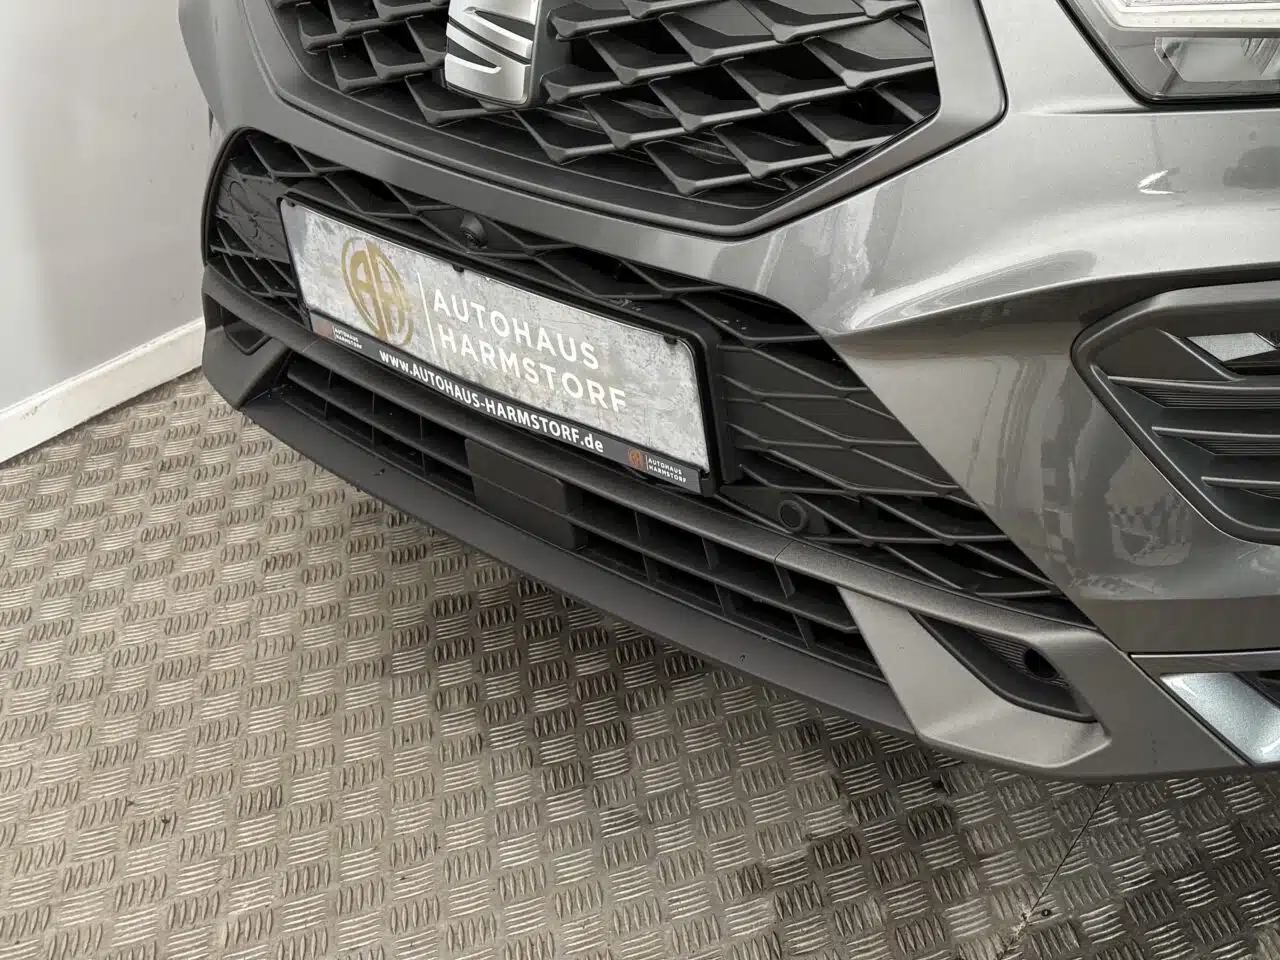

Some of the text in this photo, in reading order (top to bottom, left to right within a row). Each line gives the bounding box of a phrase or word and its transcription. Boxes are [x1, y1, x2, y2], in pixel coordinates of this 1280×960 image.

[434, 289, 599, 370] AUTOHAUS
[438, 323, 627, 412] HARMSTORF
[379, 350, 604, 453] www.AUTOHAUS-HARMSTORF.de
